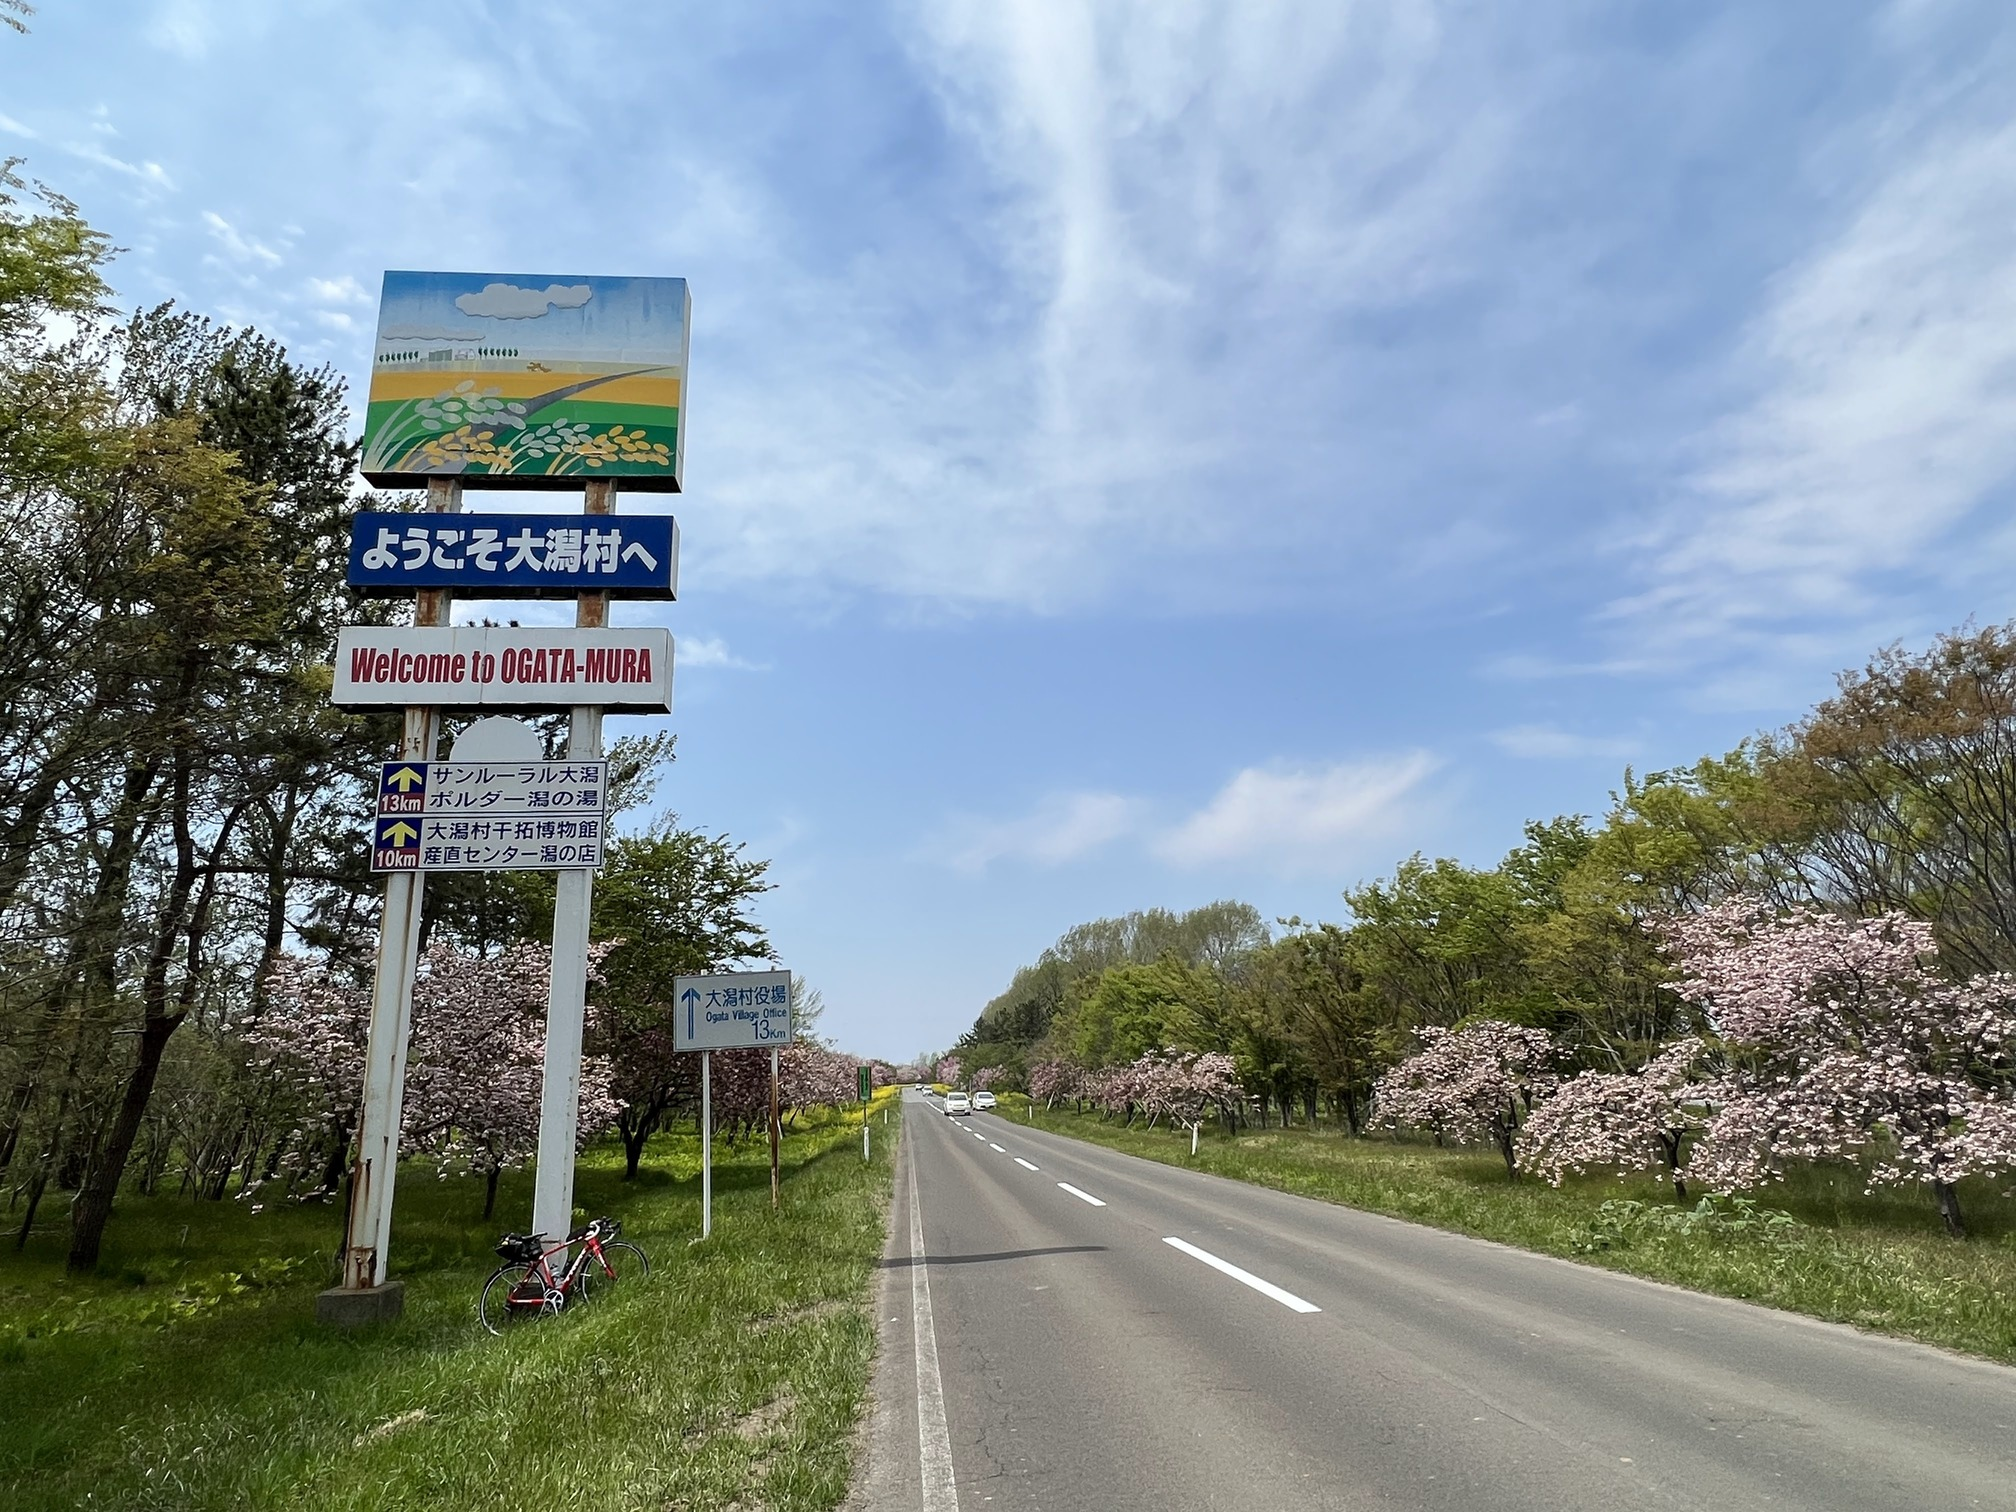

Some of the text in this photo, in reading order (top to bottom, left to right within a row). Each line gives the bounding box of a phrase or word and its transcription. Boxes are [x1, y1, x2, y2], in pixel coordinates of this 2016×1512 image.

[362, 527, 658, 573] ようこそ大潟村へ
[351, 648, 652, 684] Welcome to OGATA-MURA
[433, 766, 599, 785] サンルーラル大潟
[381, 795, 421, 812] 13km
[429, 790, 599, 808] ポルダー潟の湯
[427, 820, 598, 841] 大潟村干拓博物館
[376, 850, 417, 867] 10km
[423, 844, 597, 865] 産直センター潟の店
[705, 985, 787, 1009] 大潟村役場
[706, 1007, 787, 1024] Ogata Village Office
